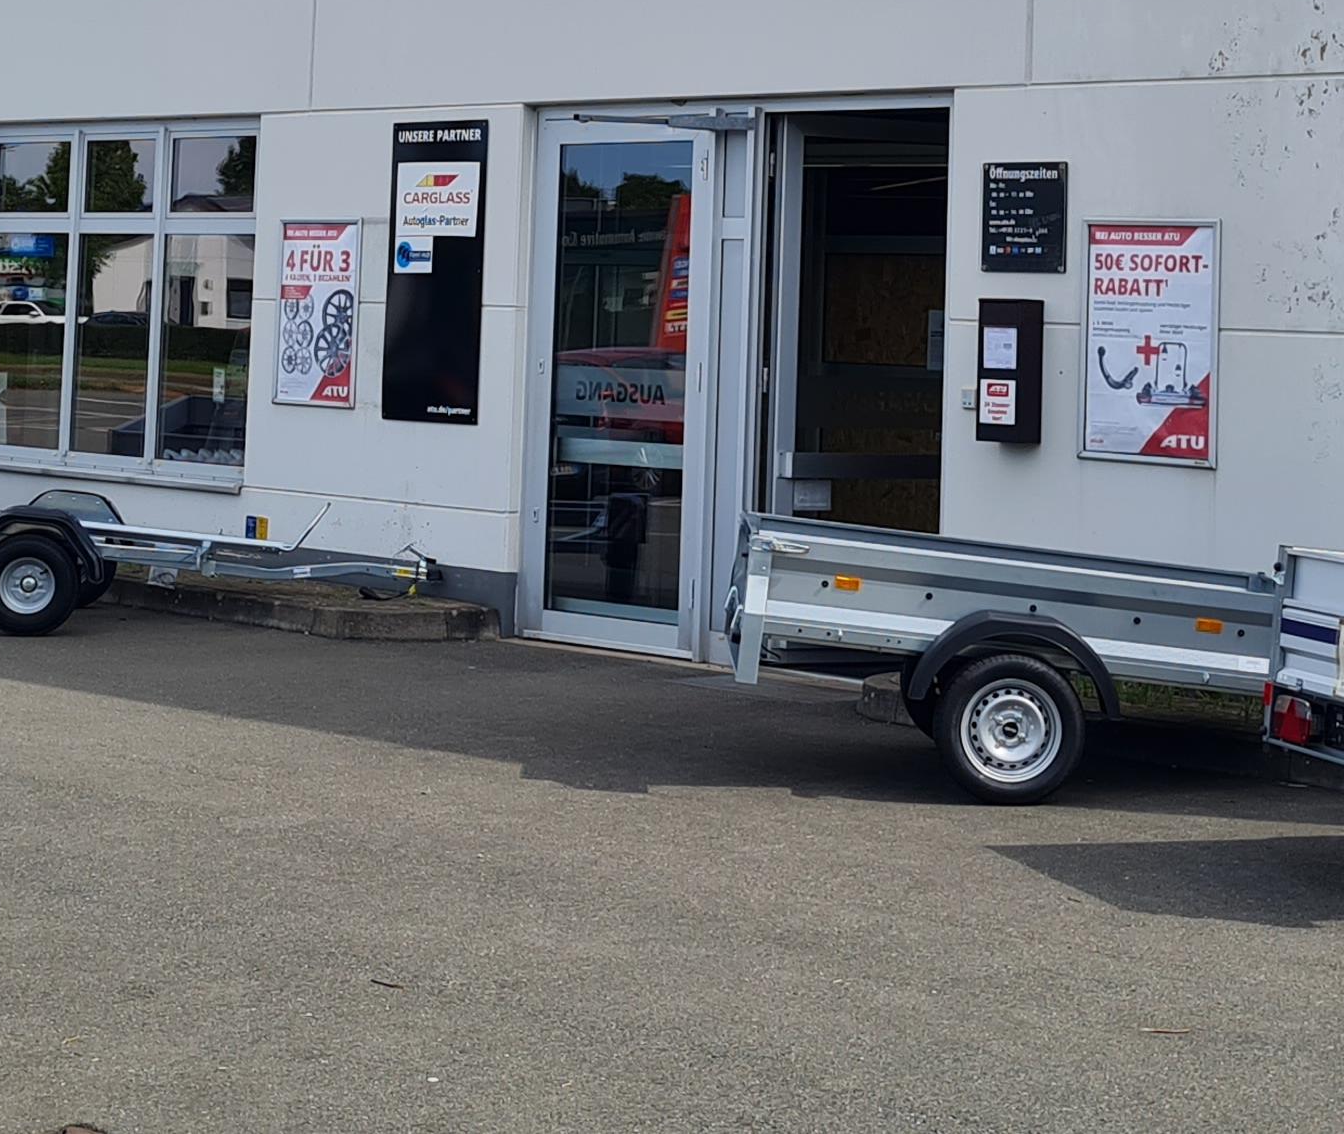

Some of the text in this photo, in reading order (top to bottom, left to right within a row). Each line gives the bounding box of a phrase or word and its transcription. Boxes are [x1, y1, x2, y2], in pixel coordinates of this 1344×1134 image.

[398, 129, 482, 143] UNSERE PARTNER
[989, 165, 1058, 182] Öffnungszeiten
[403, 215, 469, 228] Autoglas-Partner
[1109, 231, 1132, 240] AUTO
[1134, 232, 1162, 241] BESSER
[1164, 232, 1180, 241] ATU
[286, 244, 351, 272] 4 FÜR 3
[1094, 253, 1209, 274] 50€ SOFORT-
[321, 385, 348, 398] ATU
[1160, 434, 1205, 450] ATU
